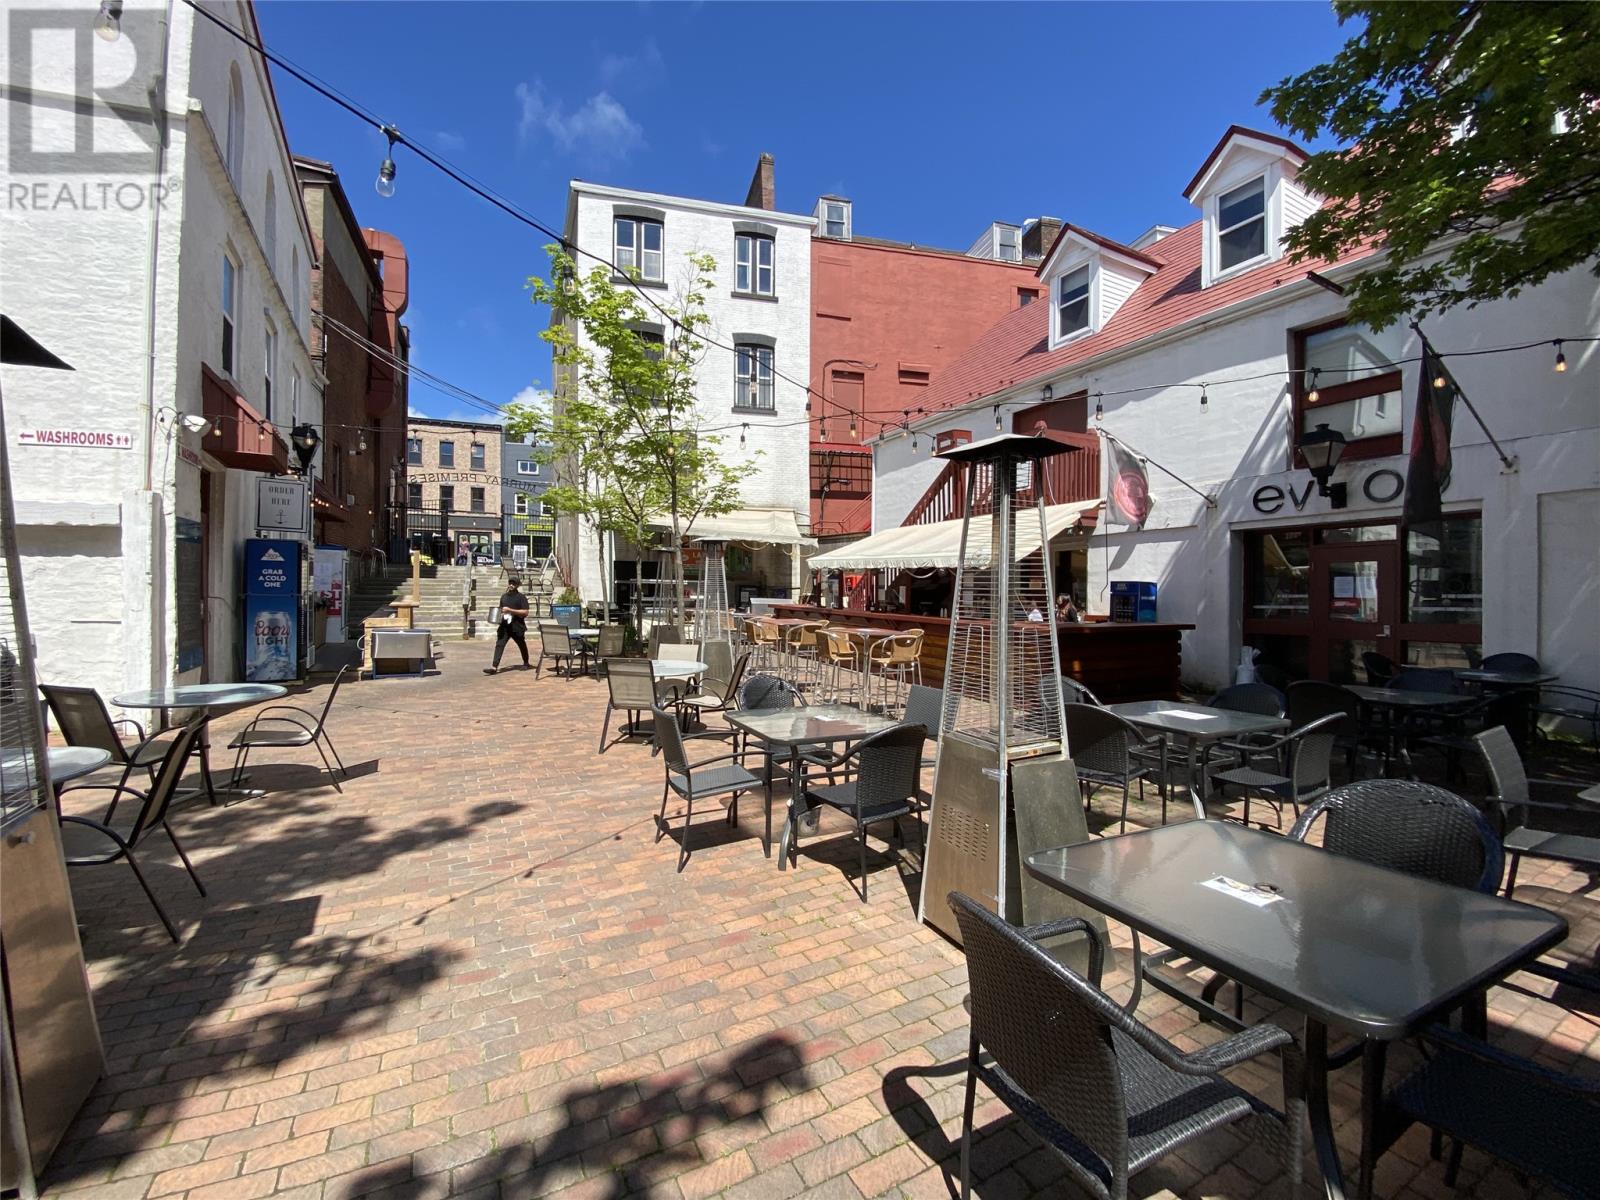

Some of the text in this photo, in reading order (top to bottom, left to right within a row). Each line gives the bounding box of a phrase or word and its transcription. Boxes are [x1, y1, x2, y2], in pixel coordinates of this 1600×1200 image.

[36, 430, 114, 445] WASHROOMS
[268, 486, 294, 495] ORDER
[271, 497, 291, 506] HERE
[256, 636, 289, 646] LIGHT
